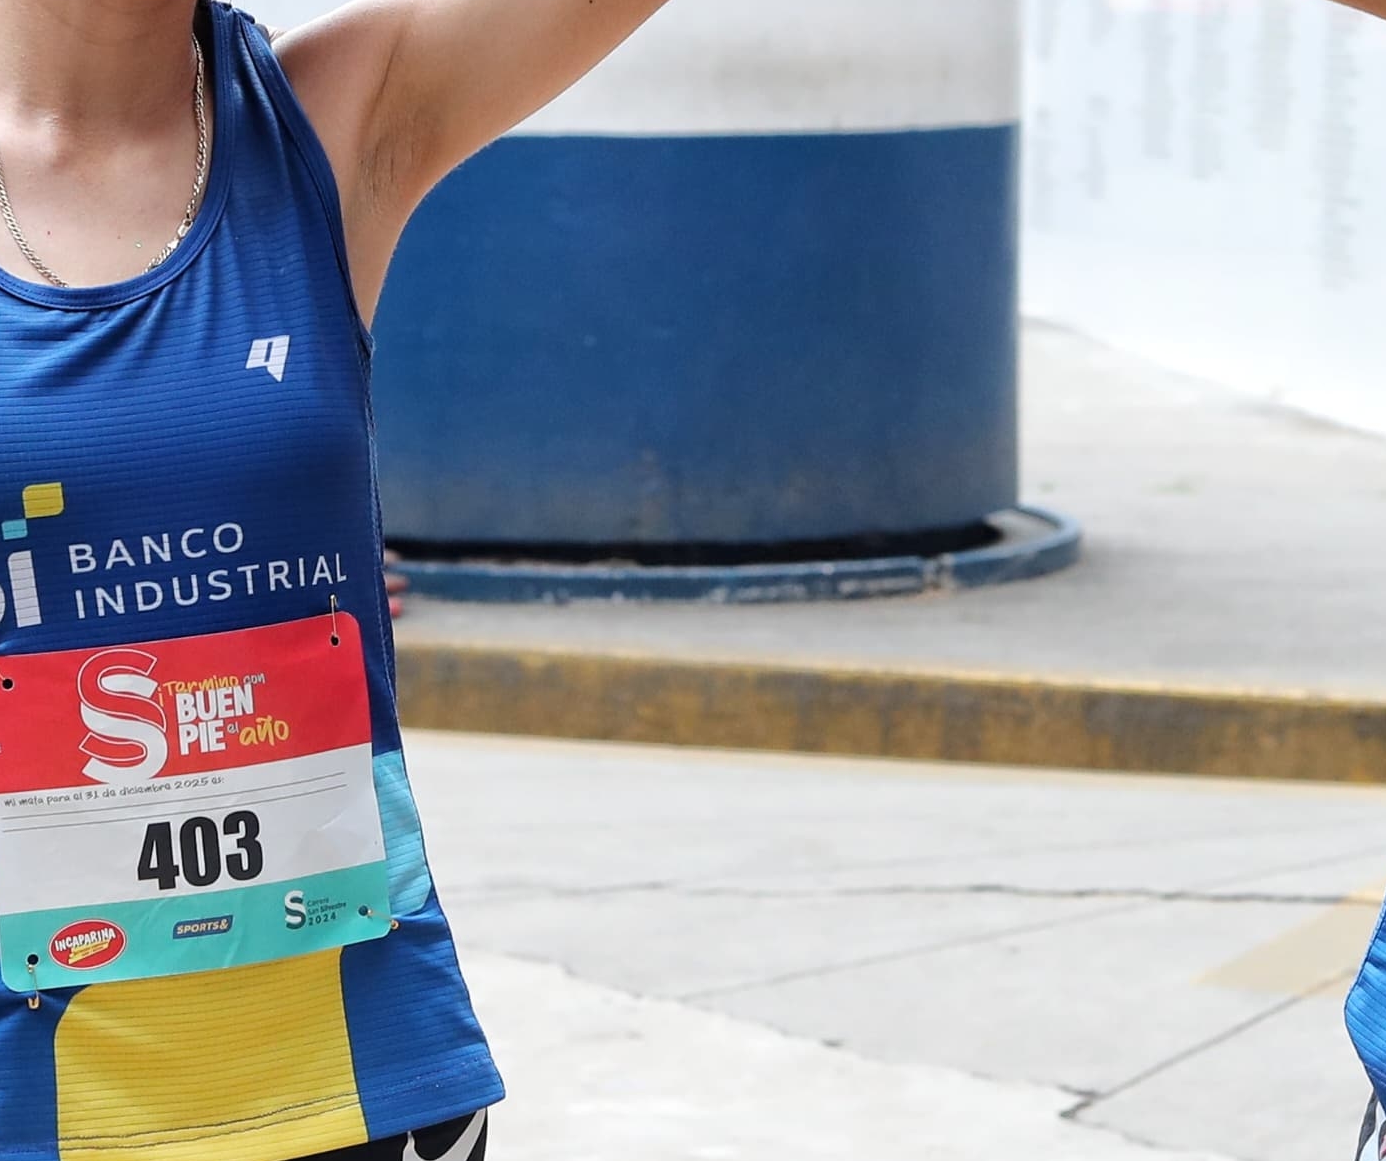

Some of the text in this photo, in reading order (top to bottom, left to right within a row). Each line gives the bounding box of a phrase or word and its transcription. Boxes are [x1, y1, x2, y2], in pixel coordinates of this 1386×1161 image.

[69, 522, 245, 574] BANCO
[74, 552, 348, 619] INDUSTRIAL
[243, 673, 265, 685] con
[176, 684, 254, 724] BUEN
[179, 715, 290, 755] PIE el año
[4, 798, 15, 807] mi
[47, 796, 70, 806] para
[73, 792, 82, 801] el
[85, 790, 98, 800] 31
[102, 788, 116, 798] de
[119, 783, 171, 796] diciembre
[174, 776, 209, 789] 2025
[137, 810, 263, 890] 403
[176, 919, 229, 935] SPORTS&
[308, 911, 336, 926] 2024
[55, 928, 116, 951] INCAPARINA
